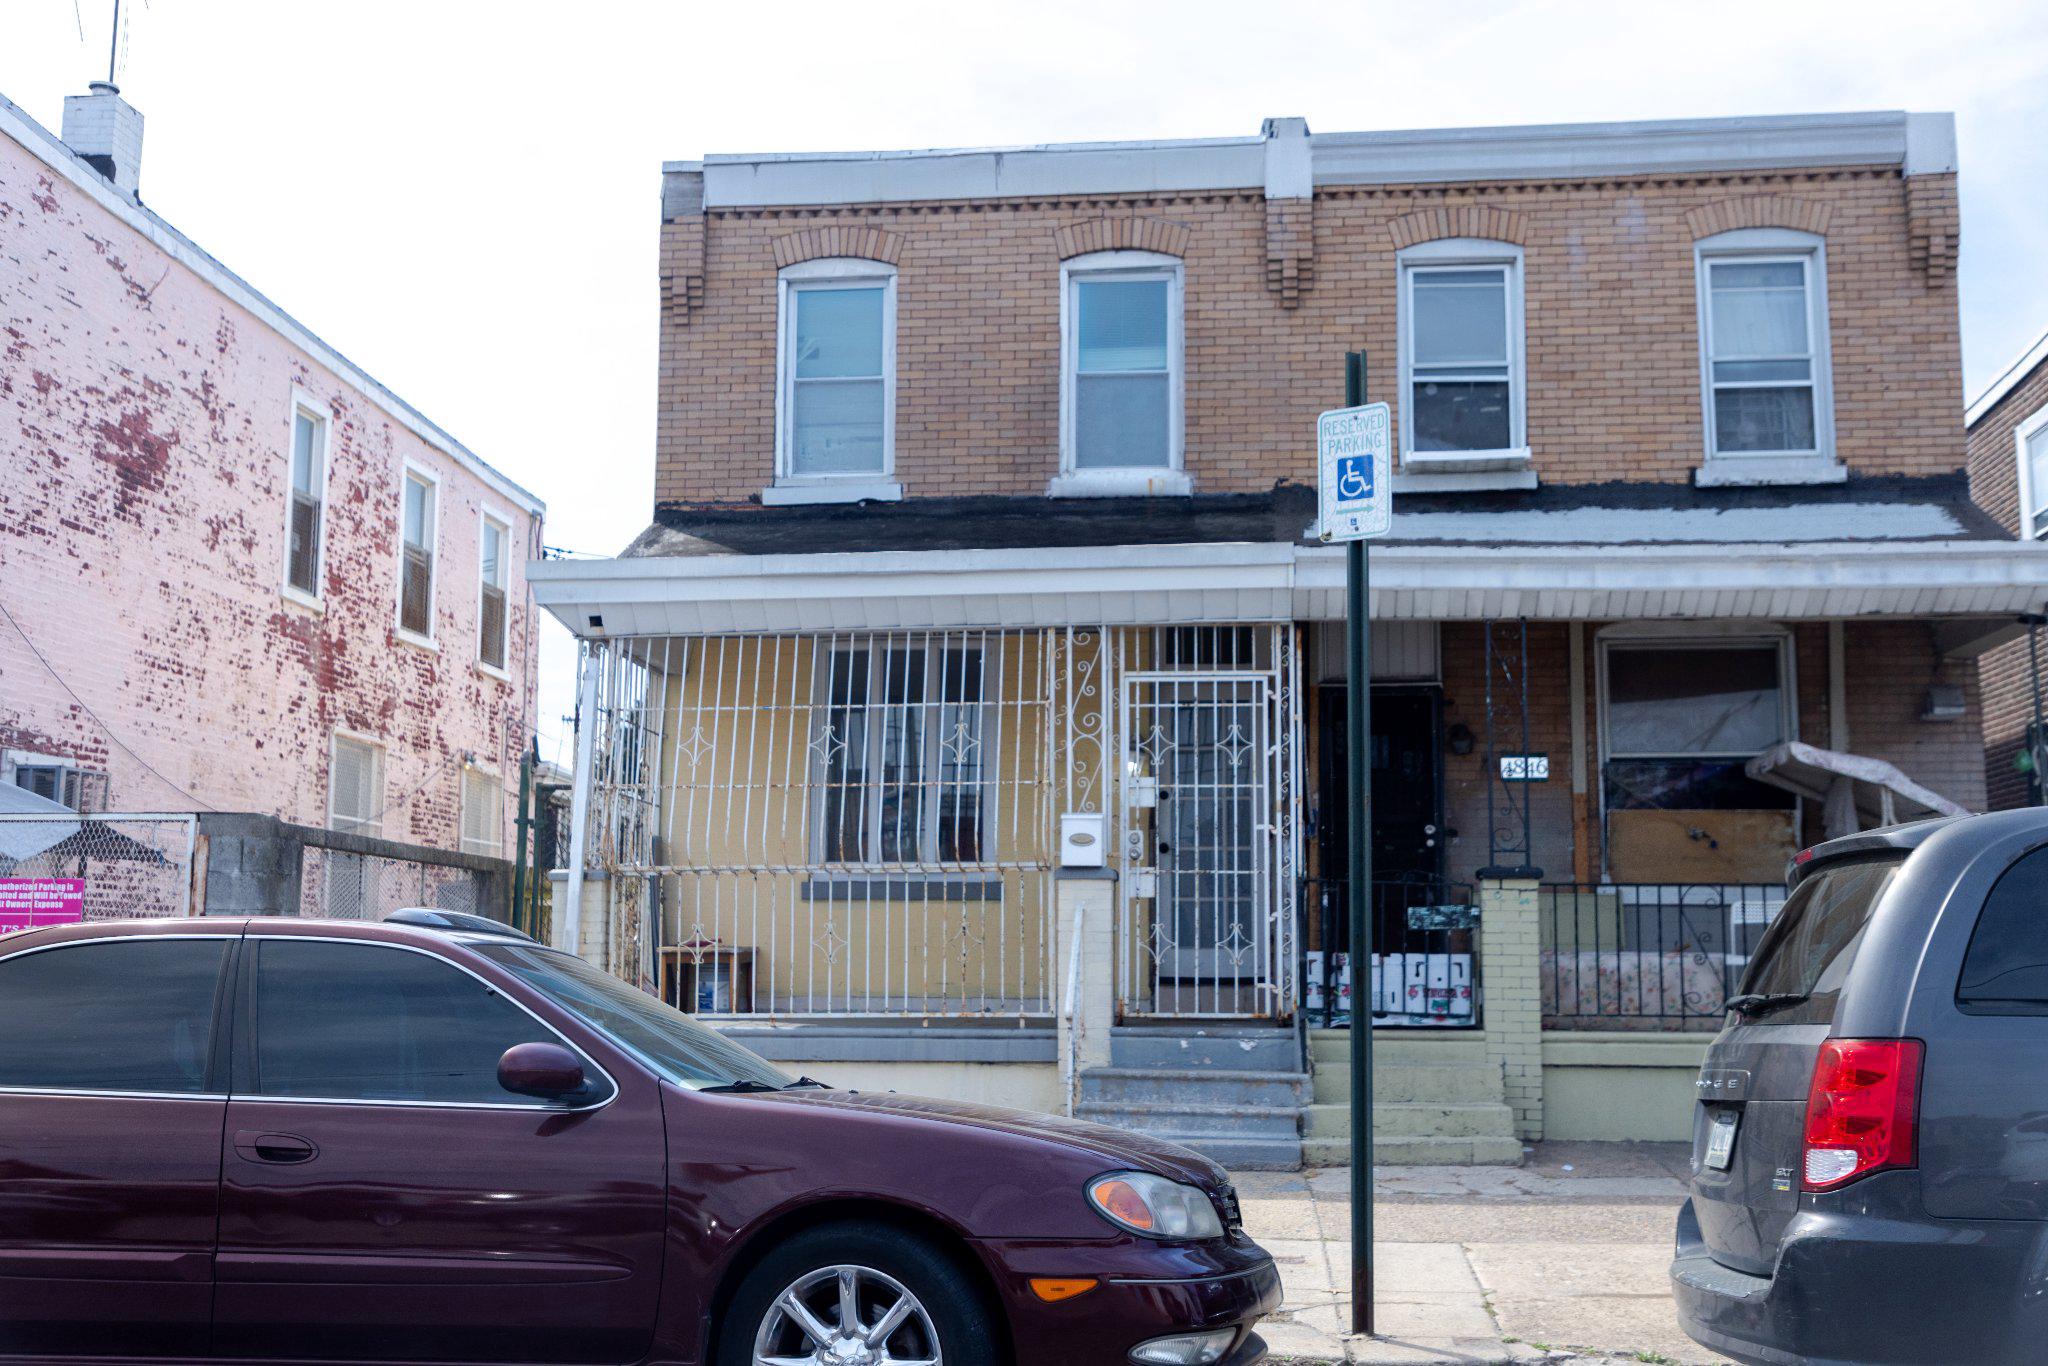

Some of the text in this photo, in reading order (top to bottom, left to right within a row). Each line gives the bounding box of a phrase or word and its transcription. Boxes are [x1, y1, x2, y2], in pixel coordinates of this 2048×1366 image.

[1323, 413, 1385, 437] RESERVED
[1328, 432, 1382, 455] PARKING
[39, 883, 66, 891] Parking
[1776, 1168, 1794, 1177] SXT
